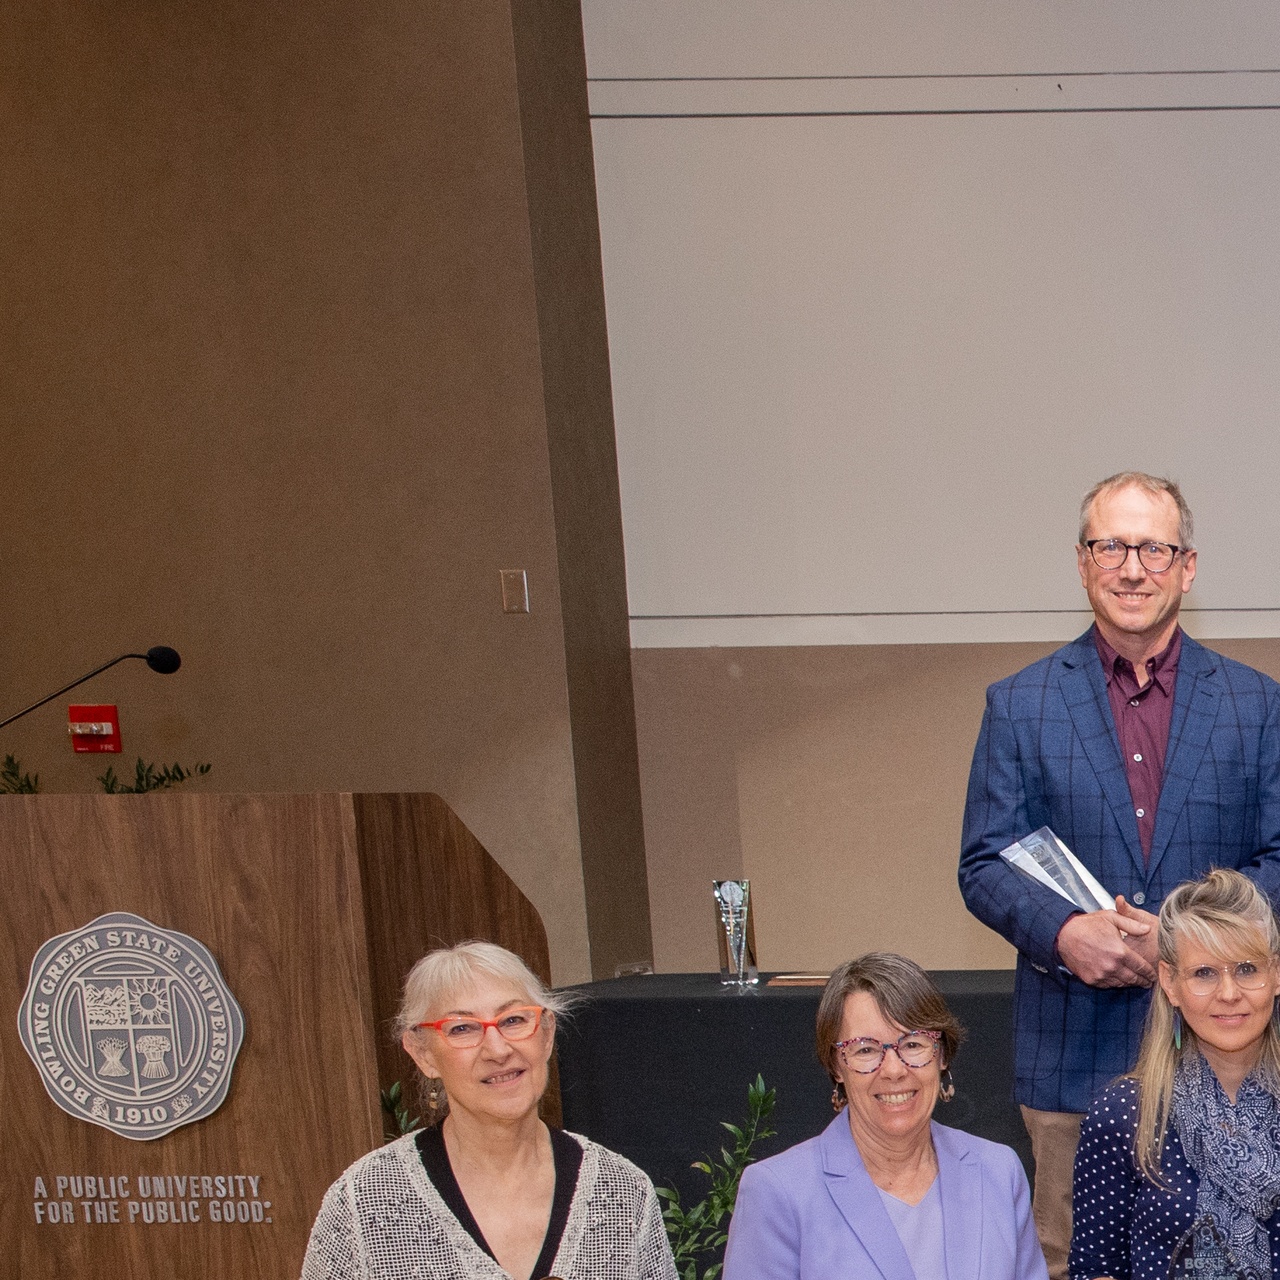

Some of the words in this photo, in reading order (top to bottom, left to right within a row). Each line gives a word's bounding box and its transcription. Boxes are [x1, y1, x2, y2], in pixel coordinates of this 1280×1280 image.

[106, 930, 182, 964] STATE
[40, 934, 100, 995] GREEN
[184, 960, 227, 1100] UNIVERSITY
[34, 1002, 92, 1104] BOWLING
[115, 1106, 168, 1123] 1910
[34, 1176, 48, 1198] A
[57, 1176, 130, 1198] PUBLIC
[140, 1176, 260, 1198] UNIVERSITY
[34, 1202, 74, 1224] FOR
[82, 1202, 120, 1224] THE
[128, 1202, 200, 1224] PUBLIC
